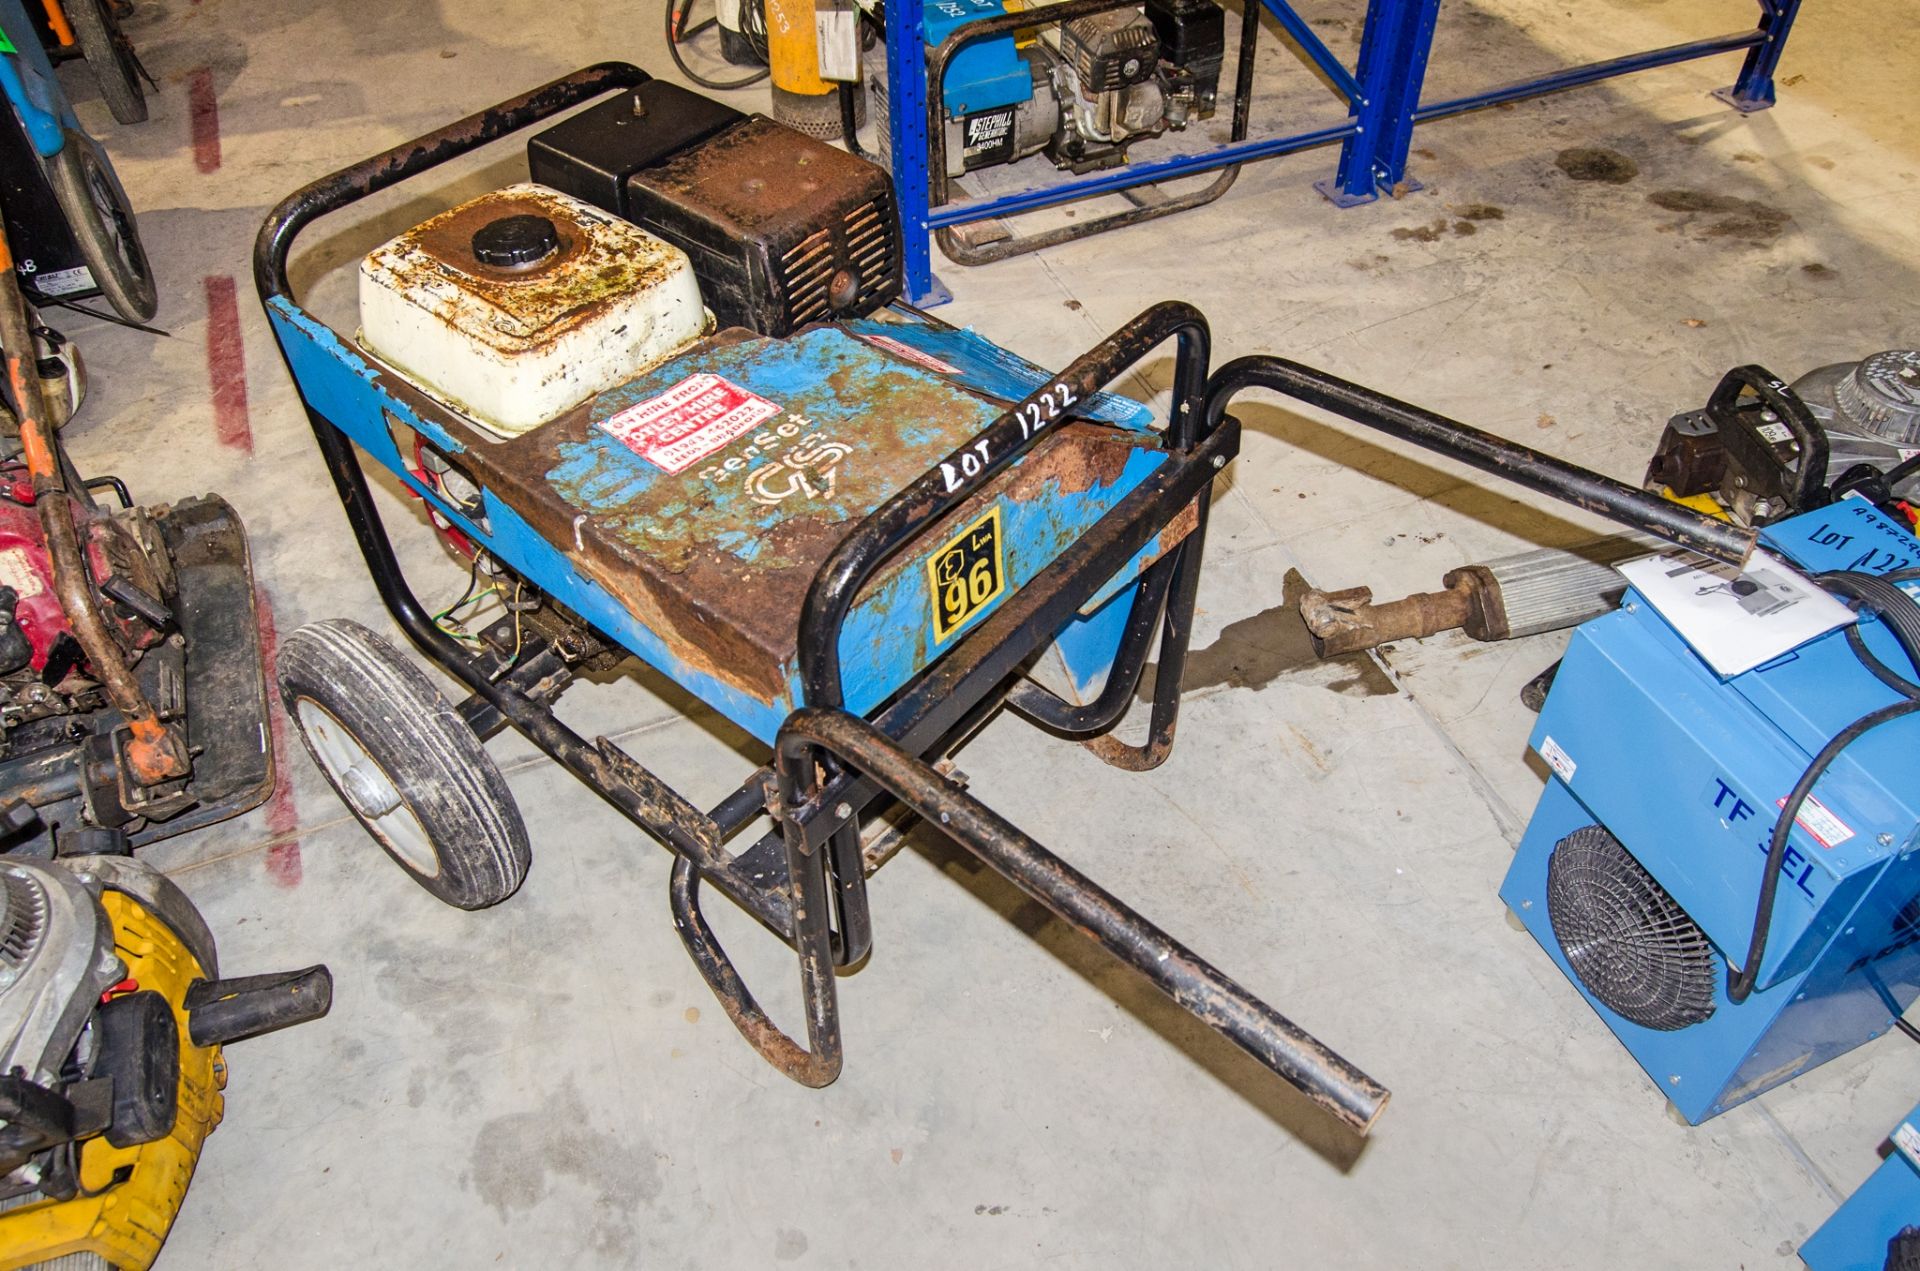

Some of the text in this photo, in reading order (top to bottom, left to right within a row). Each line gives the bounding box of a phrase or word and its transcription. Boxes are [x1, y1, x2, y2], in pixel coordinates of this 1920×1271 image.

[976, 111, 1012, 132] STEPHILL
[638, 401, 671, 419] HIRE
[687, 387, 730, 414] HIRE
[659, 402, 728, 442] CENTRE
[940, 439, 989, 493] LOT
[1015, 383, 1077, 440] 1222
[1808, 524, 1855, 550] LOT
[945, 557, 993, 624] 96
[1714, 777, 1756, 822] TF
